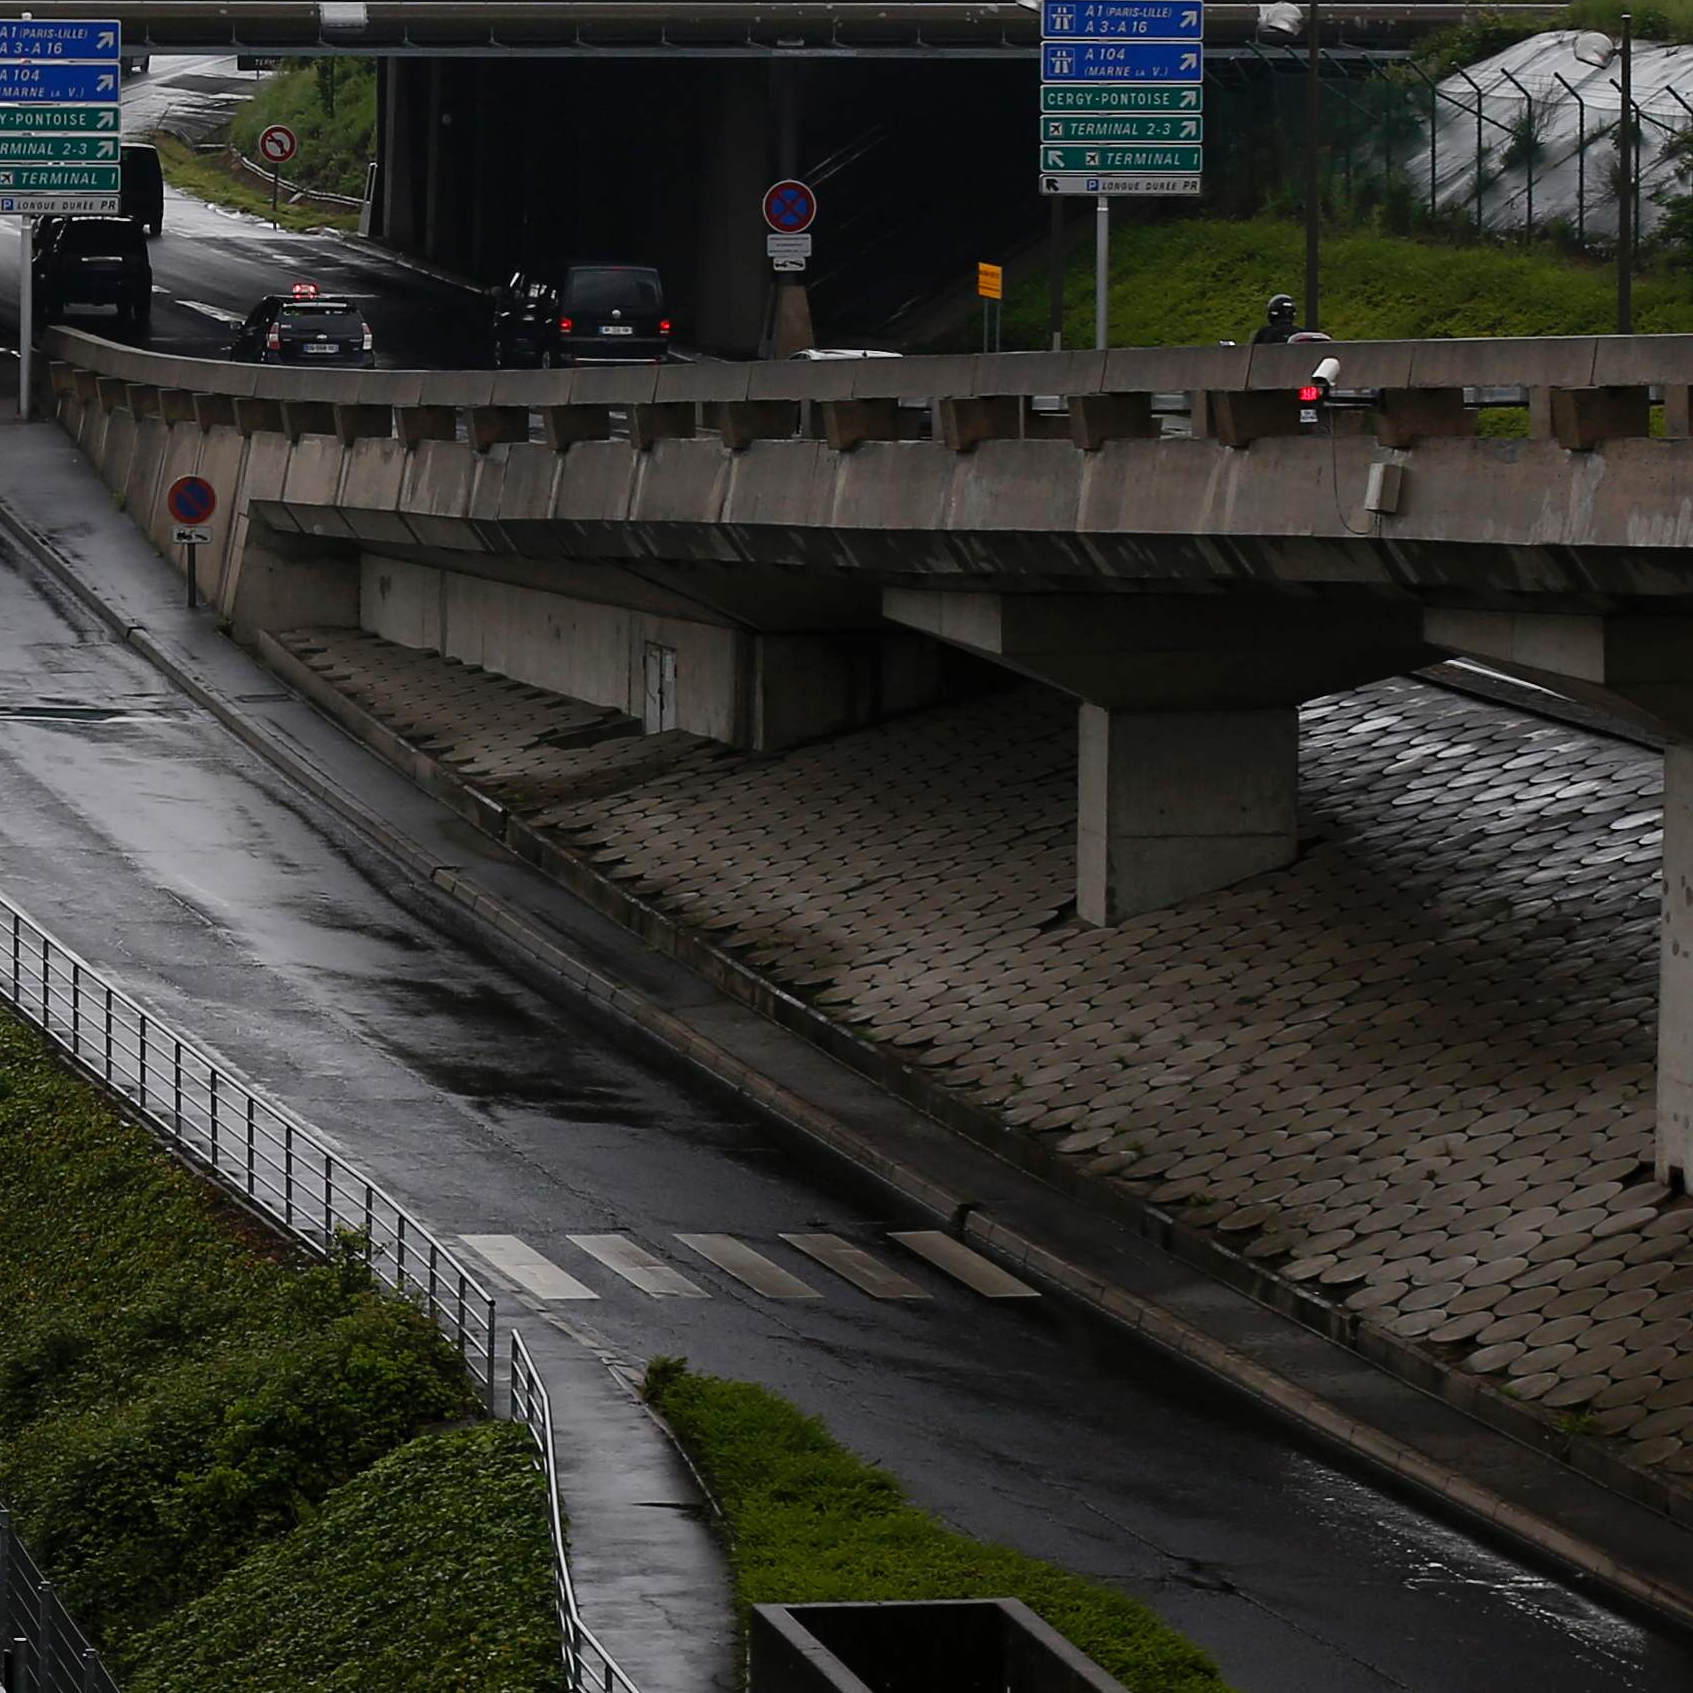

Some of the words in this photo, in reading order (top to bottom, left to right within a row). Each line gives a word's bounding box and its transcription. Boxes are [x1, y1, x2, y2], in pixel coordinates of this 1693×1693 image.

[1085, 5, 1103, 16] A1
[1106, 7, 1172, 18] (PARIS-LILLE)
[0, 26, 17, 38] A1
[20, 28, 87, 39] (PARIS-LILLE)
[1132, 21, 1147, 33] 16
[47, 42, 62, 54] 16
[1085, 49, 1094, 60] A
[1100, 48, 1125, 60] 104
[14, 69, 40, 81] 104
[1085, 66, 1130, 77] (MARNE
[1047, 93, 1170, 105] CERGY-PONTOISE
[1071, 123, 1138, 135] TERMINAL
[1147, 123, 1171, 135] 2-3
[62, 143, 88, 155] 2-3
[1107, 153, 1180, 165] TERMINAL
[1193, 153, 1198, 165] 1
[22, 172, 98, 184] TERMINAL
[111, 173, 116, 184] 1
[1182, 180, 1198, 190] PR
[100, 200, 116, 210] PR
